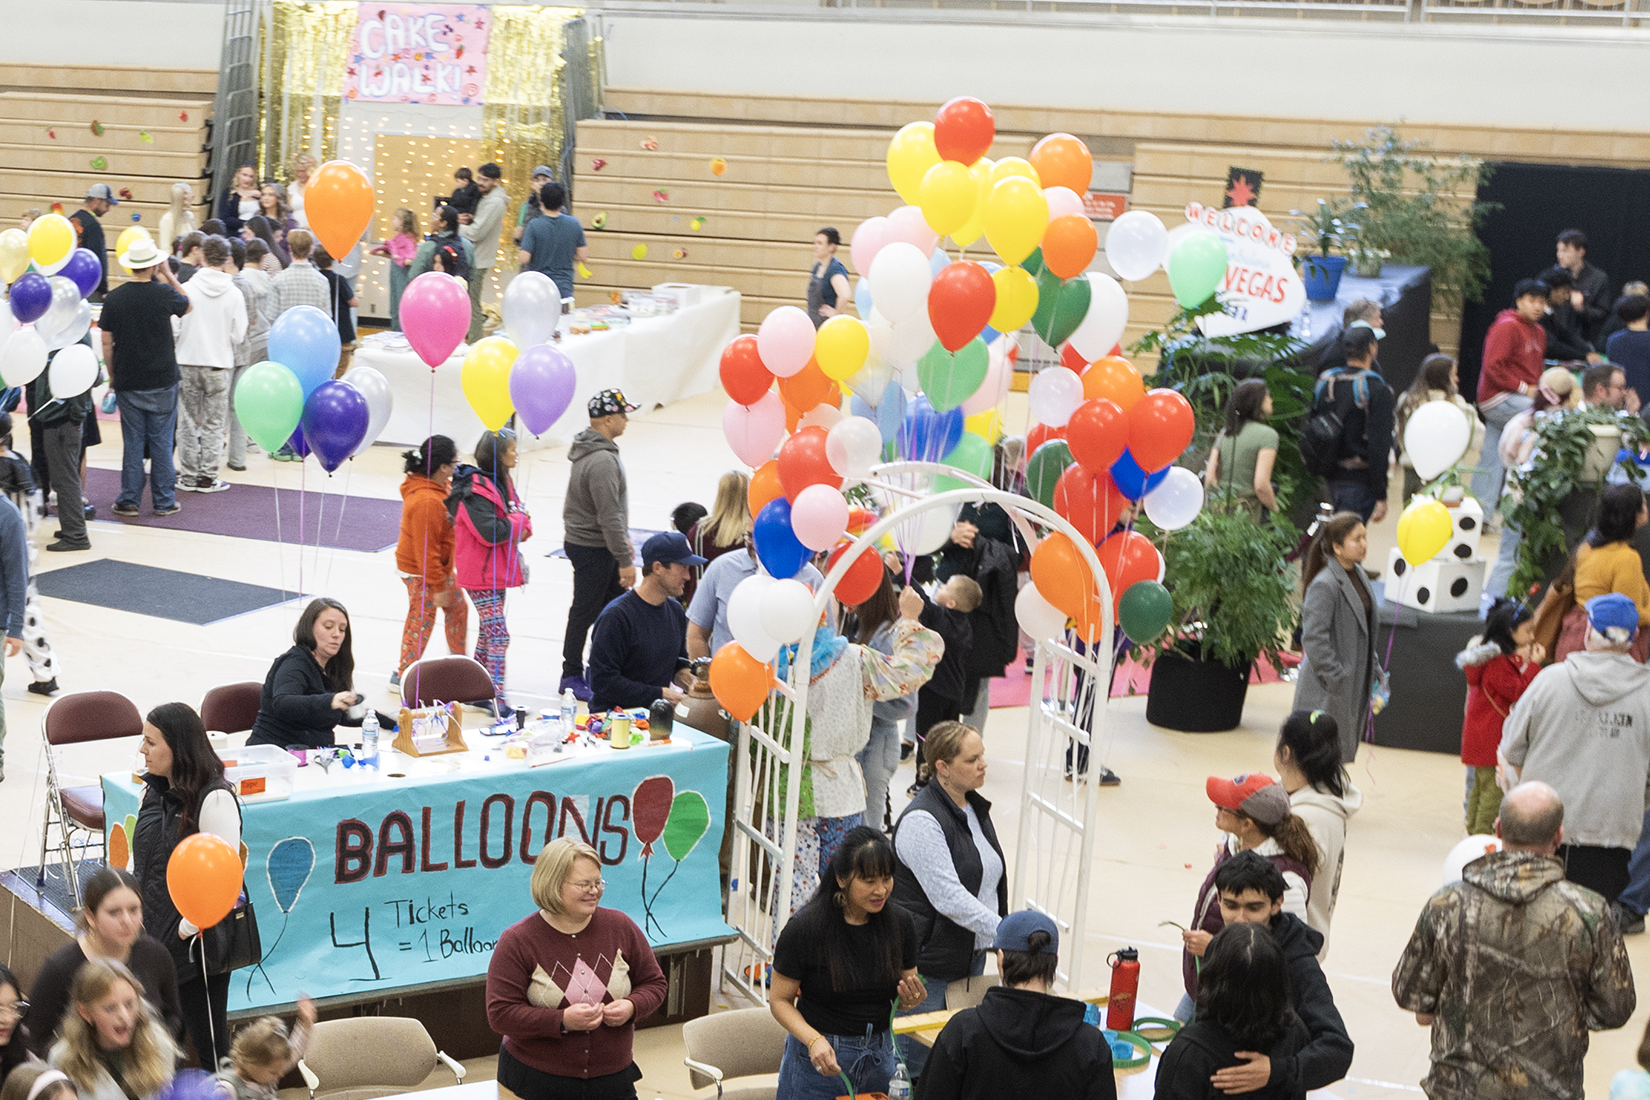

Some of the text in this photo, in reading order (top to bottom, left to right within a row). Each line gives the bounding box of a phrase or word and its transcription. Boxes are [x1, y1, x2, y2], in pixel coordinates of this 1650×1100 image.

[360, 13, 450, 60] CAKE
[359, 62, 462, 100] WALK!
[1188, 203, 1296, 253] WELCOME
[1225, 264, 1288, 304] VEGAS
[334, 790, 631, 884] BALLOONS
[330, 890, 469, 980] 4 Tickets
[417, 929, 439, 963] 1
